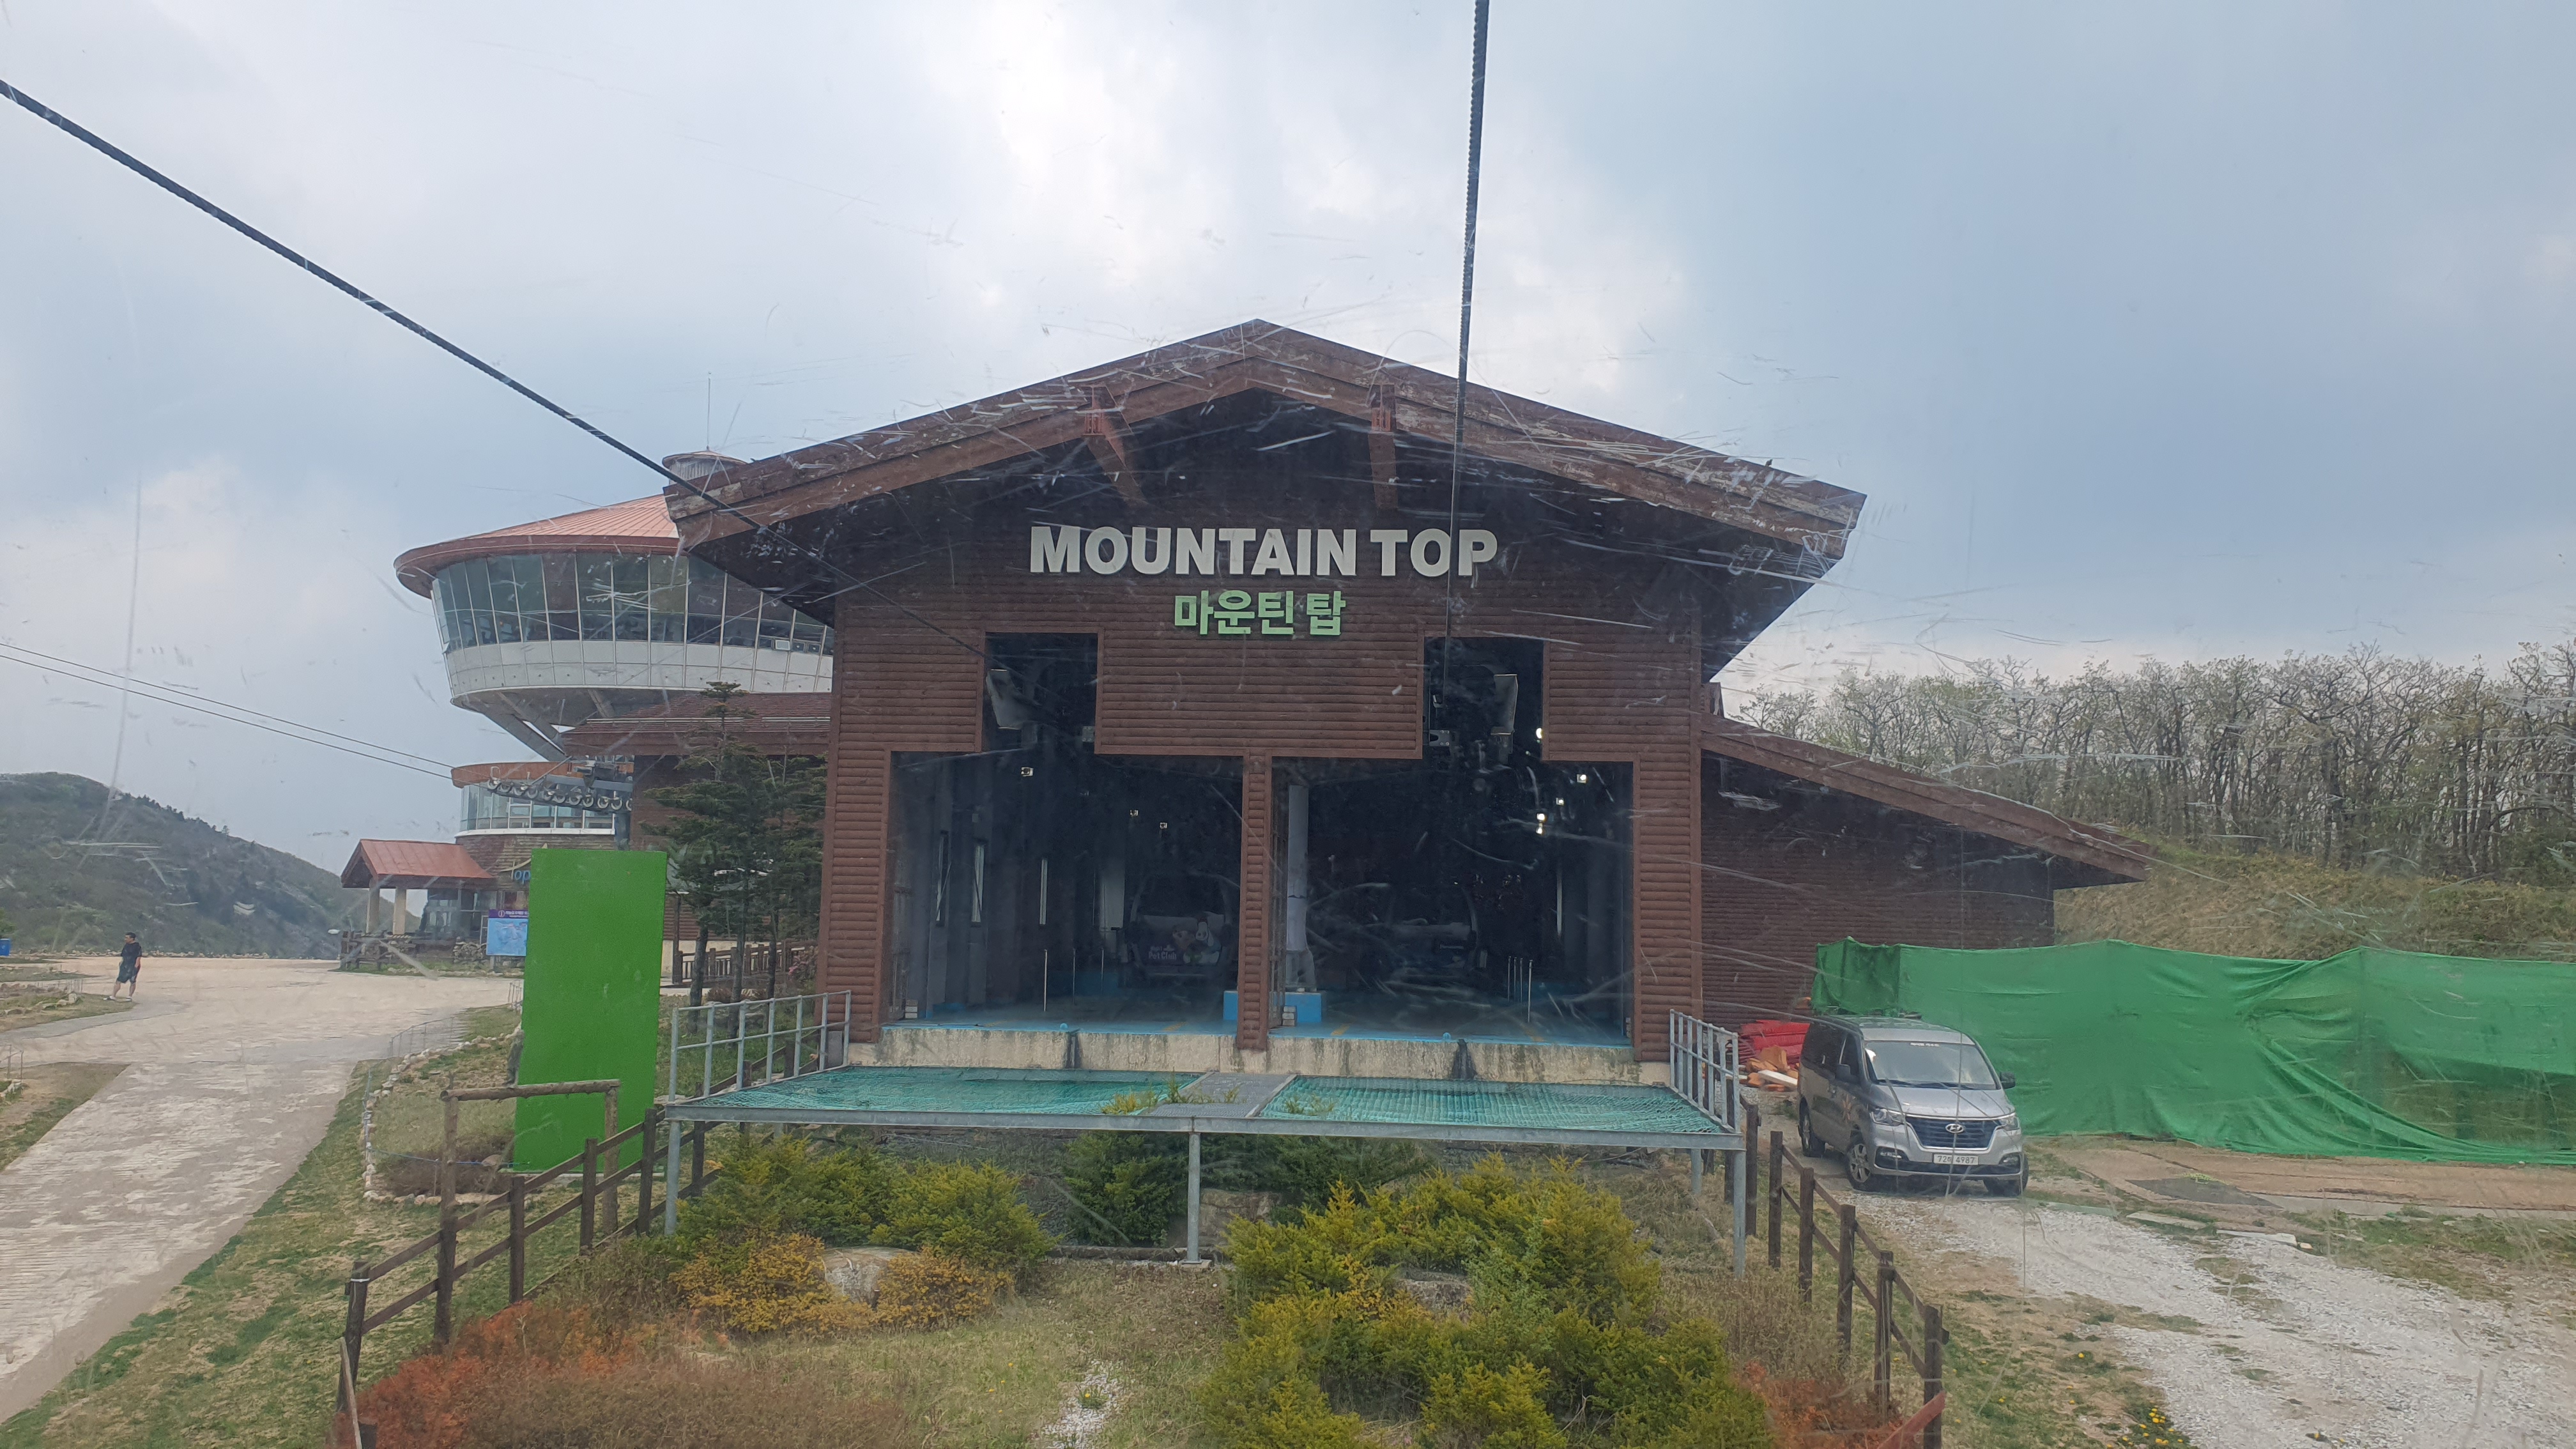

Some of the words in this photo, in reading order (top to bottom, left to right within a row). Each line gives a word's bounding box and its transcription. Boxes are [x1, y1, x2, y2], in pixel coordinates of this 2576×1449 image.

[1030, 526, 1356, 576] MOUNTAIN
[1370, 528, 1498, 578] TOP
[1174, 590, 1294, 635] 마운틴
[1307, 590, 1346, 636] 탑
[1955, 1156, 1975, 1164] 4987
